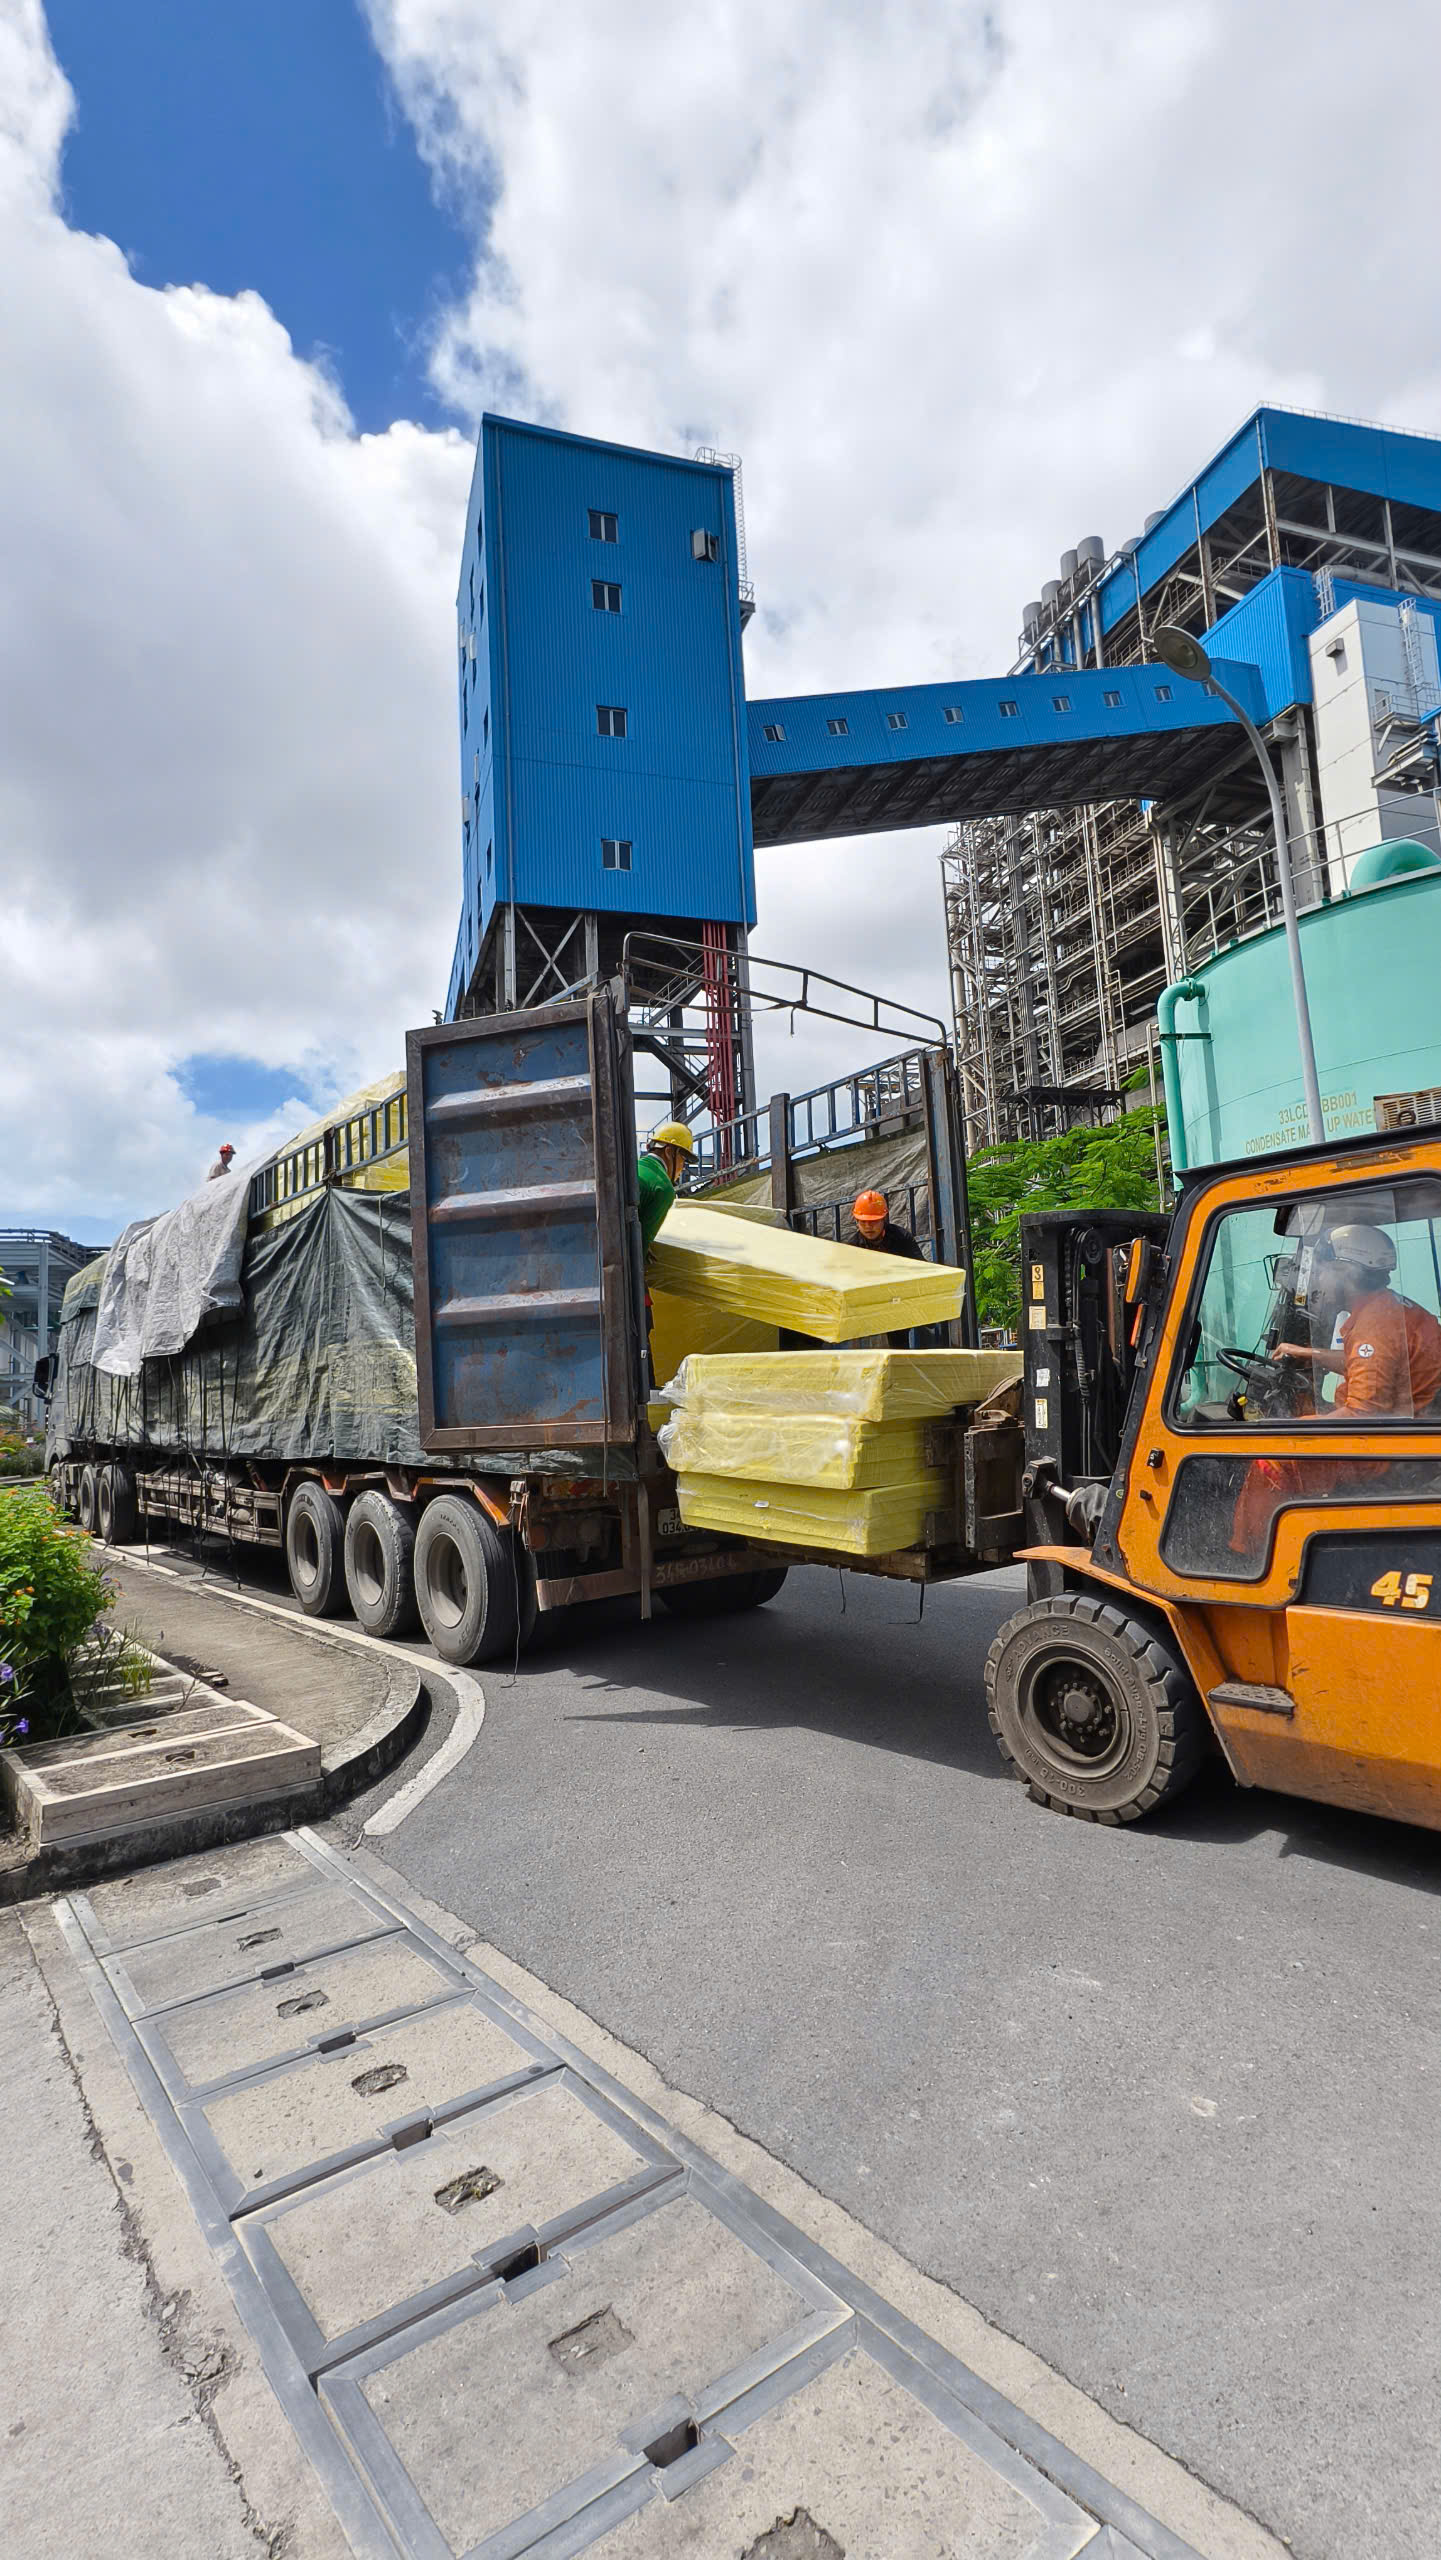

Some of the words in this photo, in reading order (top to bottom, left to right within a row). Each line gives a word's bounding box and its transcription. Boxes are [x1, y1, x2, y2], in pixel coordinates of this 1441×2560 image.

[1245, 1128, 1297, 1155] CONDENSATE
[1327, 1114, 1341, 1133] UP
[1343, 1108, 1376, 1128] WATE
[1371, 1570, 1434, 1609] 45
[1013, 1624, 1070, 1659] ADVANCE
